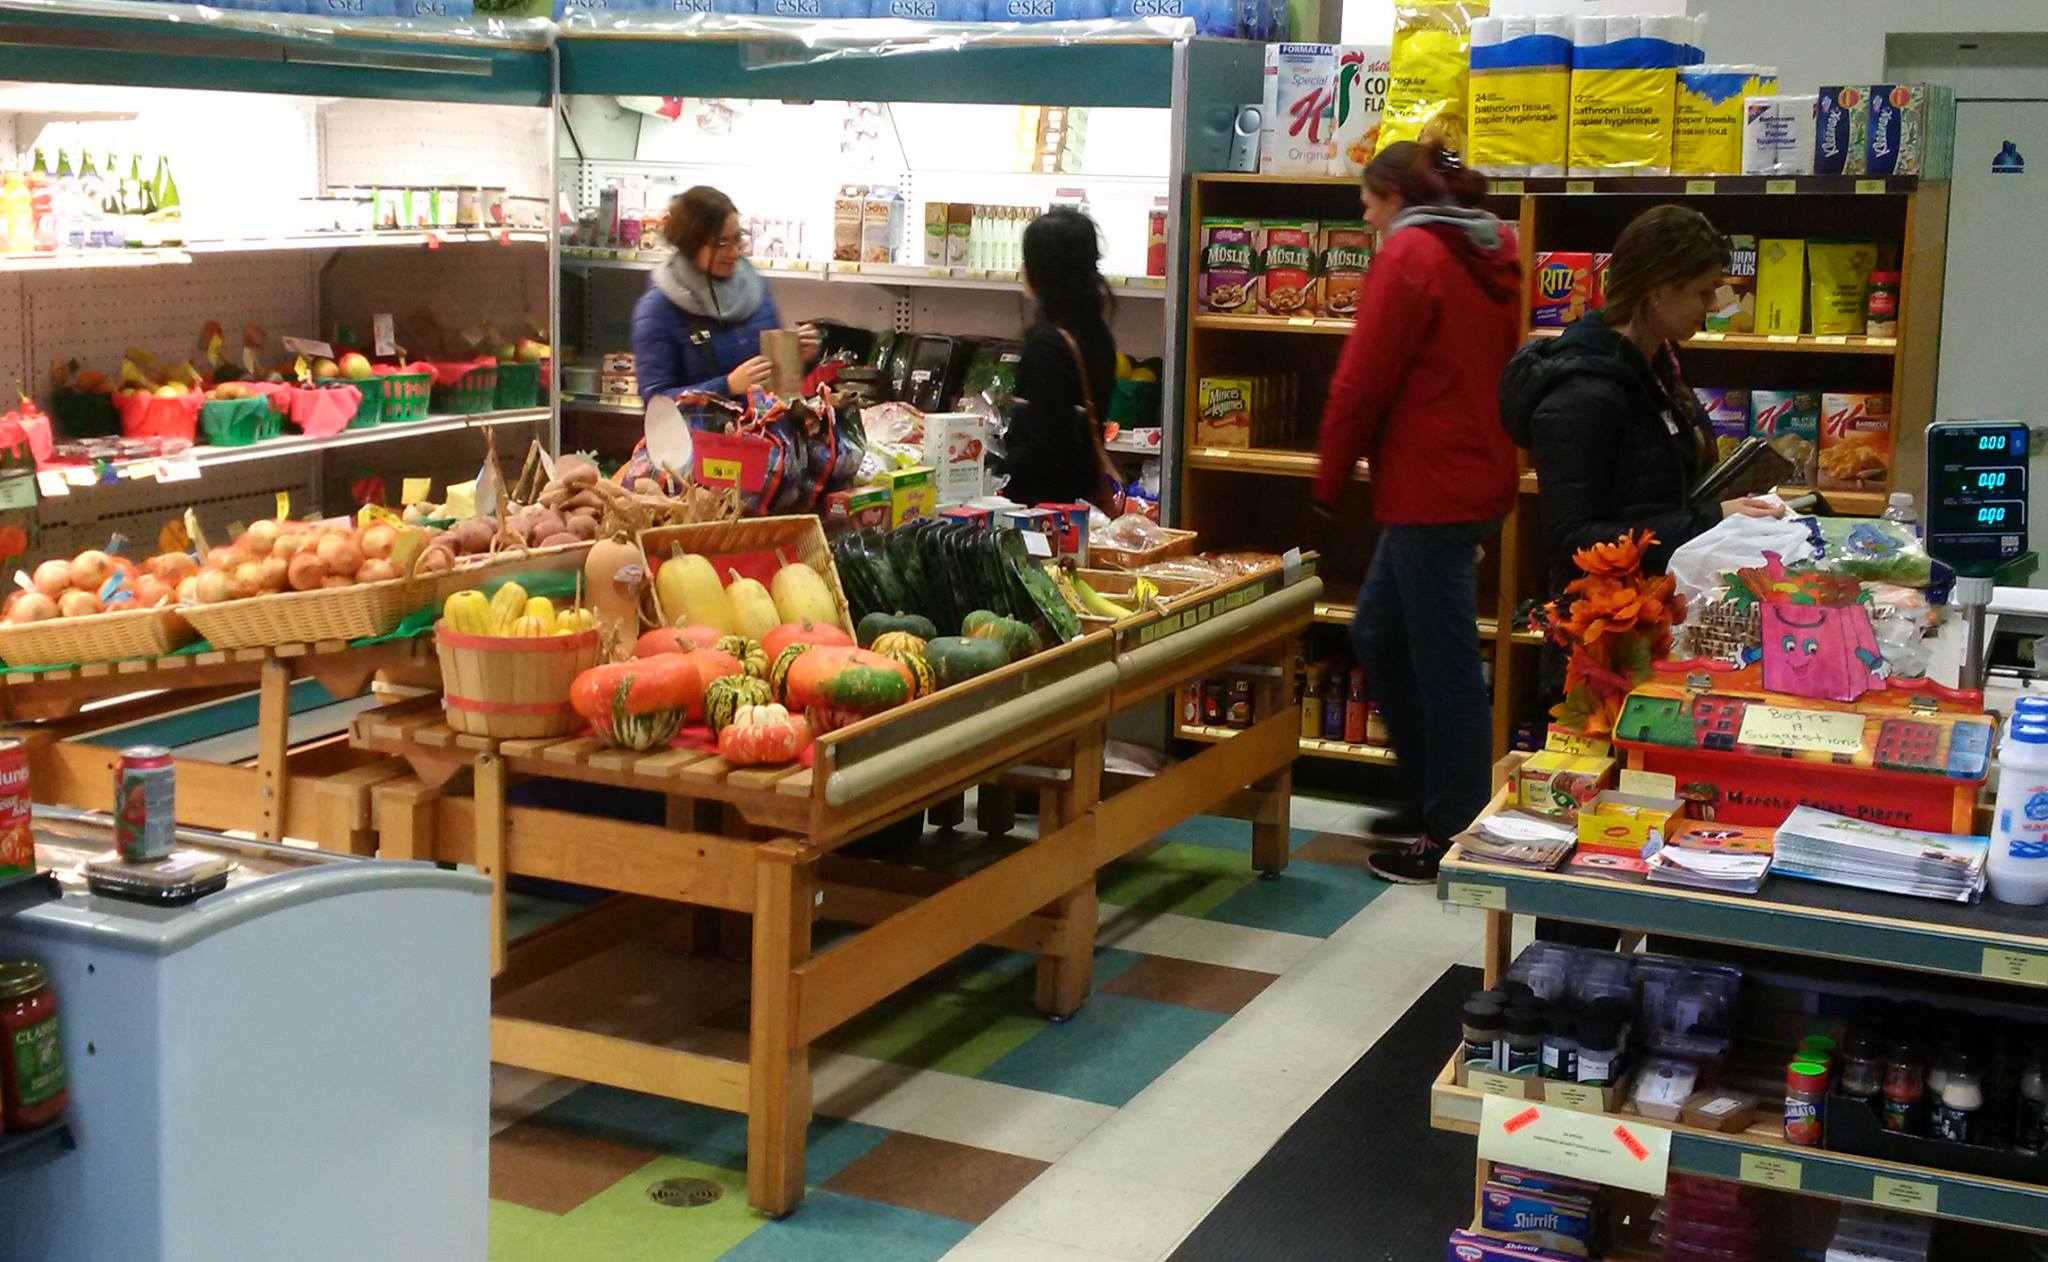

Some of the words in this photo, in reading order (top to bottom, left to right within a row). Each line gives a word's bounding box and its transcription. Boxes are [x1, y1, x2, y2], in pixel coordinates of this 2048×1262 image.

[415, 2, 447, 17] eska
[672, 0, 713, 13] eska
[773, 0, 821, 15] eska
[889, 0, 937, 18] eska
[1007, 0, 1056, 17] eska
[1131, 0, 1183, 15] eska
[1283, 44, 1318, 55] FORMAT
[1367, 61, 1391, 73] Kell
[1291, 73, 1328, 87] Special
[1364, 97, 1386, 113] FLA
[1474, 93, 1487, 103] 24
[1288, 86, 1333, 145] K
[1474, 102, 1521, 114] bathroom
[1522, 102, 1552, 112] tissue
[1573, 106, 1620, 115] bathroom
[1622, 106, 1653, 115] tissue
[1474, 114, 1502, 126] papier
[1573, 116, 1603, 128] papier
[1821, 109, 1842, 158] Kleenex
[1872, 109, 1893, 158] Kleenex
[1288, 147, 1331, 164] Origina
[1731, 263, 1756, 276] PLUS
[1540, 268, 1574, 295] RITZ
[1513, 1212, 1560, 1231] Shirriff
